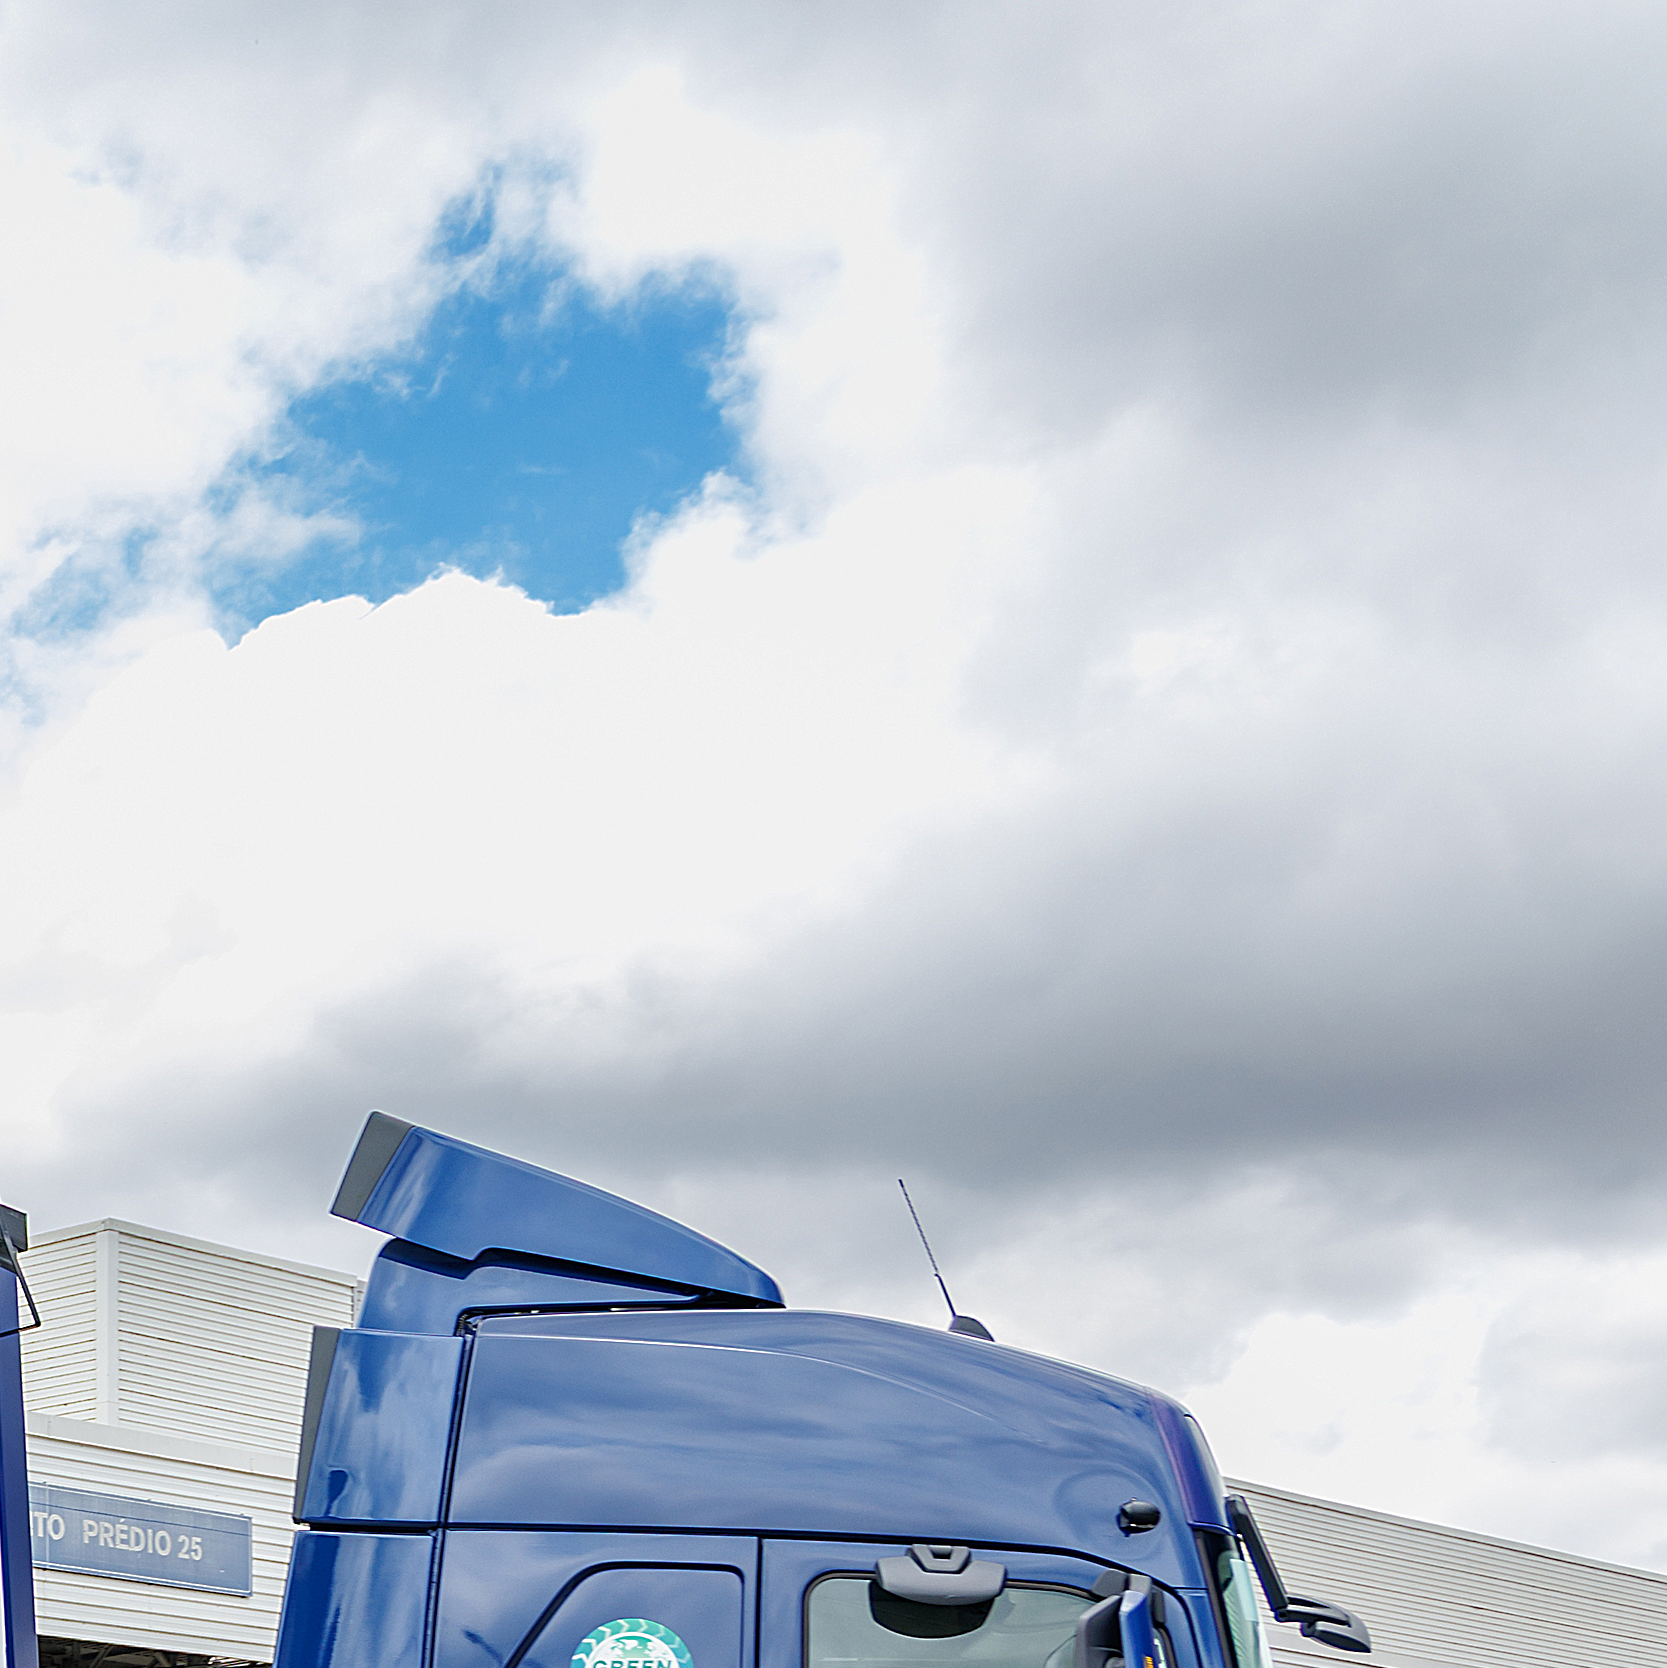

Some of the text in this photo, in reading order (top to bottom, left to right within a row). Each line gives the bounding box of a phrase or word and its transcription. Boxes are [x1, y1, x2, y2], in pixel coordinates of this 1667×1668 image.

[29, 1510, 203, 1561] TO PRÉDIO 25
